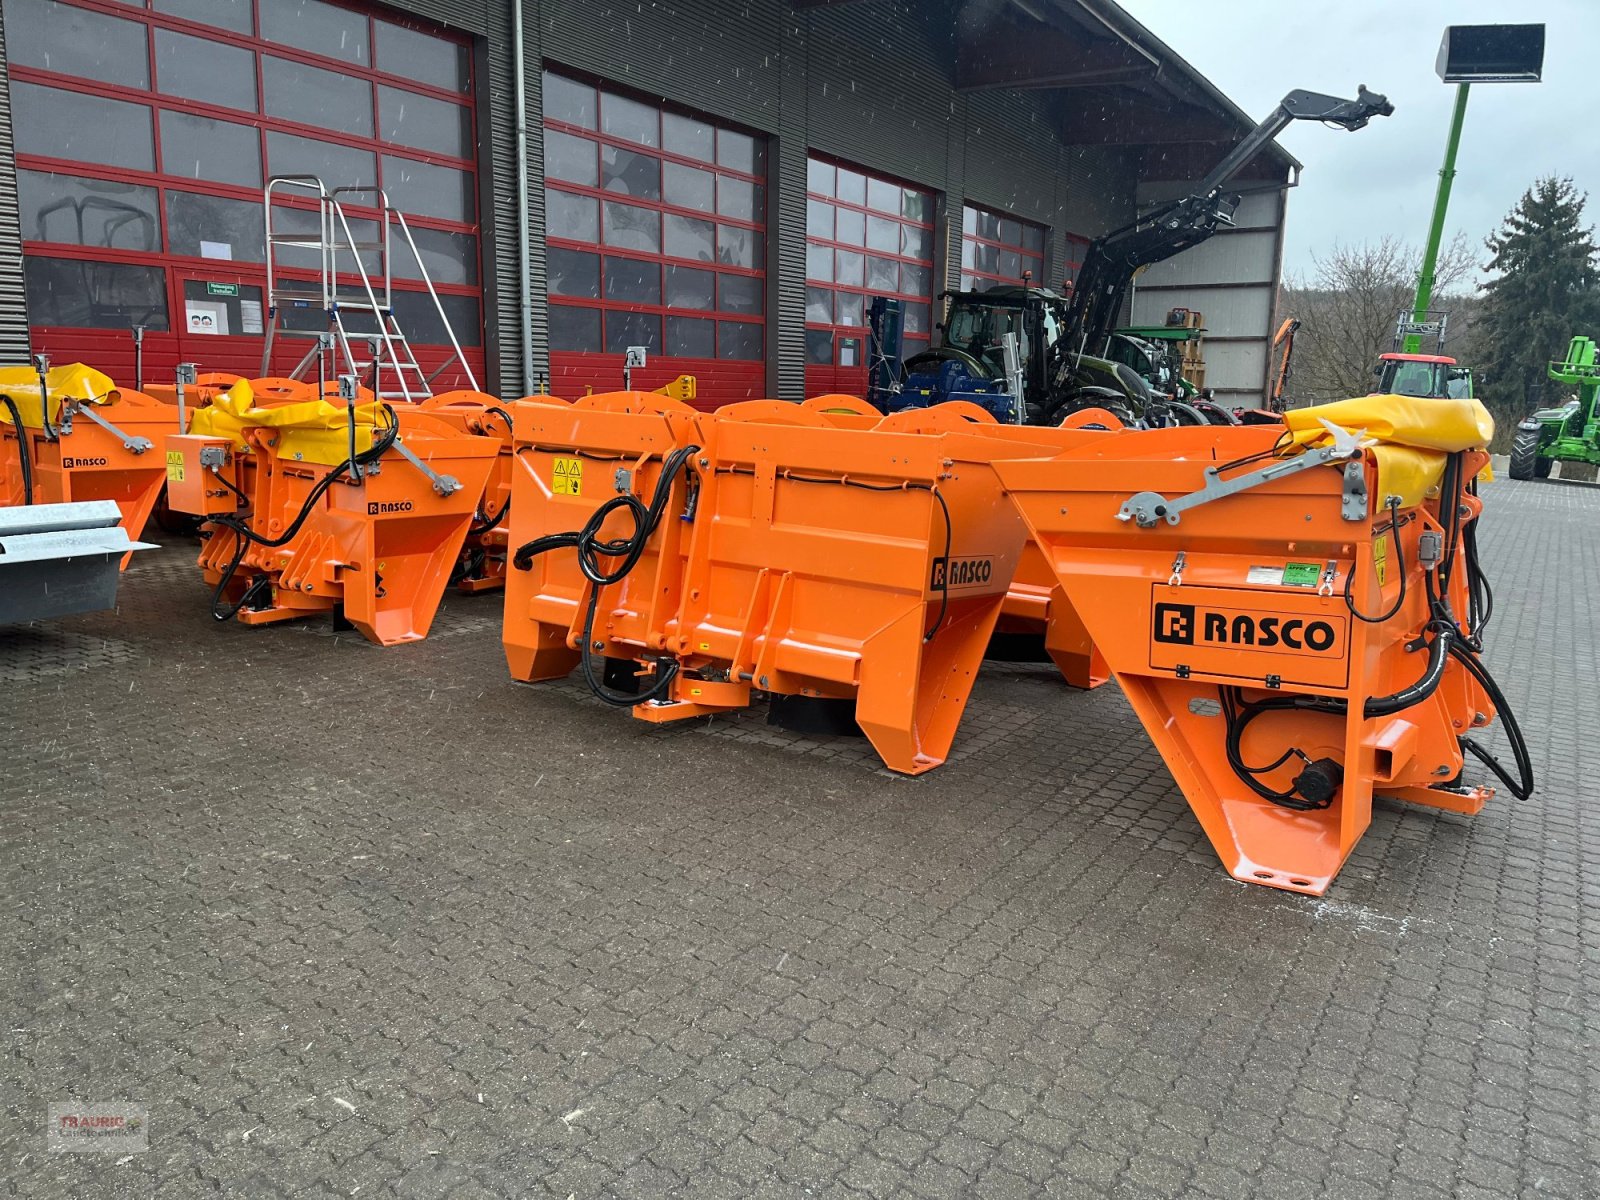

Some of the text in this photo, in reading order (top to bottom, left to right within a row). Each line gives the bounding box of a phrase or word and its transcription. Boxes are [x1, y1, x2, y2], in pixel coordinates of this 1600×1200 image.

[76, 458, 106, 466] RASCO
[381, 502, 412, 512] RASCO
[949, 560, 991, 584] RASCO
[1204, 612, 1335, 651] RASCO
